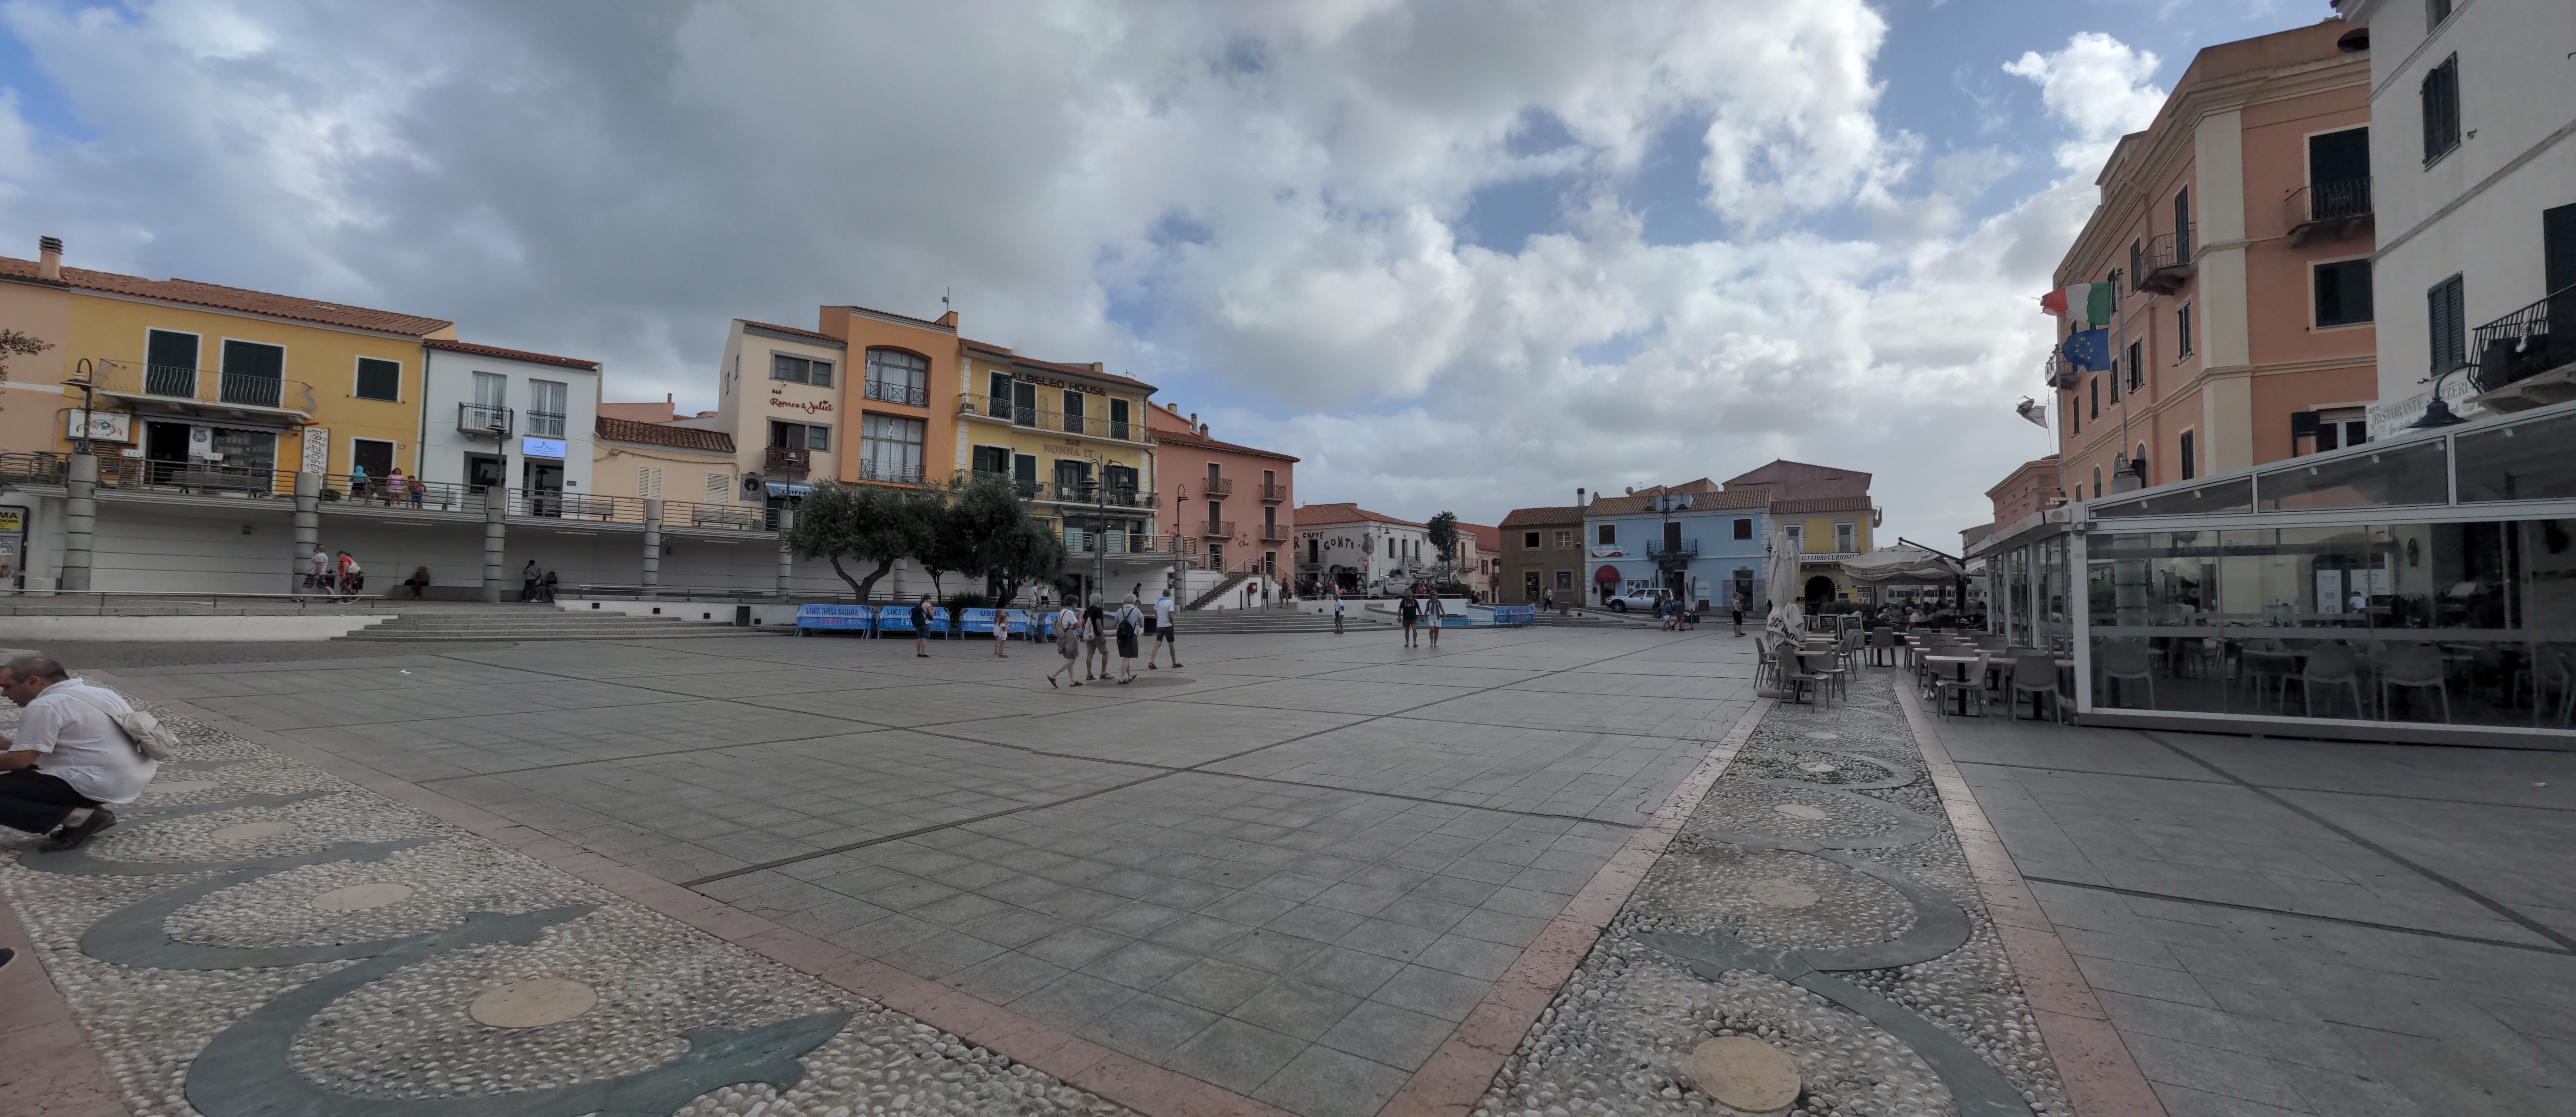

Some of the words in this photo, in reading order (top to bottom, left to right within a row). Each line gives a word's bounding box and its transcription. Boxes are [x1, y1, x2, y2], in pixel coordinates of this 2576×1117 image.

[1011, 372, 1064, 389] ALBELEO
[1069, 383, 1106, 396] HOUSE
[770, 398, 801, 408] Romeo
[807, 400, 834, 414] Juliet
[2373, 397, 2425, 425] RISTORANTE
[1044, 444, 1080, 456] NONNA
[820, 617, 845, 625] EVENTI
